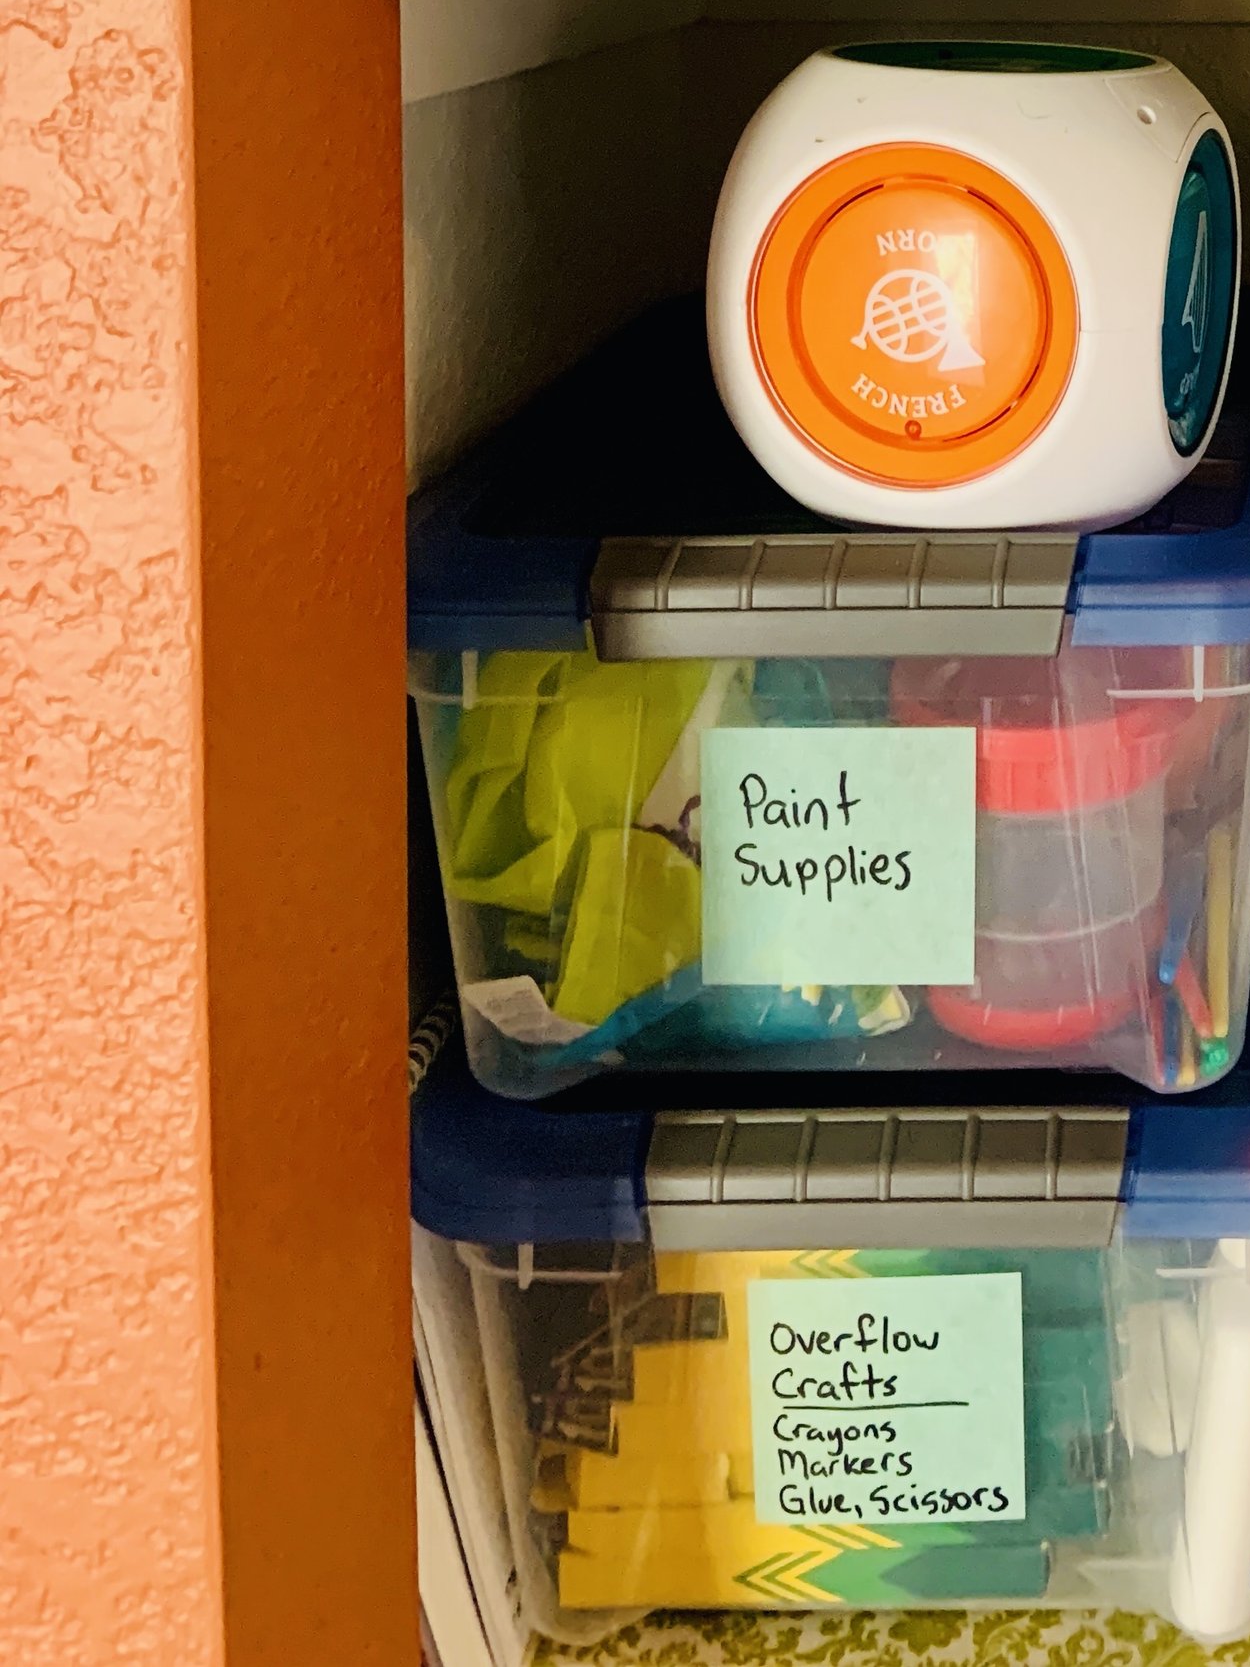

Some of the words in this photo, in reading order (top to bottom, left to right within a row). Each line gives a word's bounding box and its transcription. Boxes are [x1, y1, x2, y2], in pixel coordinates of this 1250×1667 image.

[876, 227, 940, 257] ORN
[850, 373, 966, 419] FRENCH
[739, 770, 861, 831] Paint
[734, 842, 911, 902] Supplies
[770, 1313, 940, 1355] Overflow
[772, 1361, 898, 1401] Crafts
[773, 1414, 897, 1456] Crayons
[777, 1448, 913, 1480] Markers
[779, 1484, 863, 1519] Glue,
[869, 1484, 1010, 1516] Scissors
